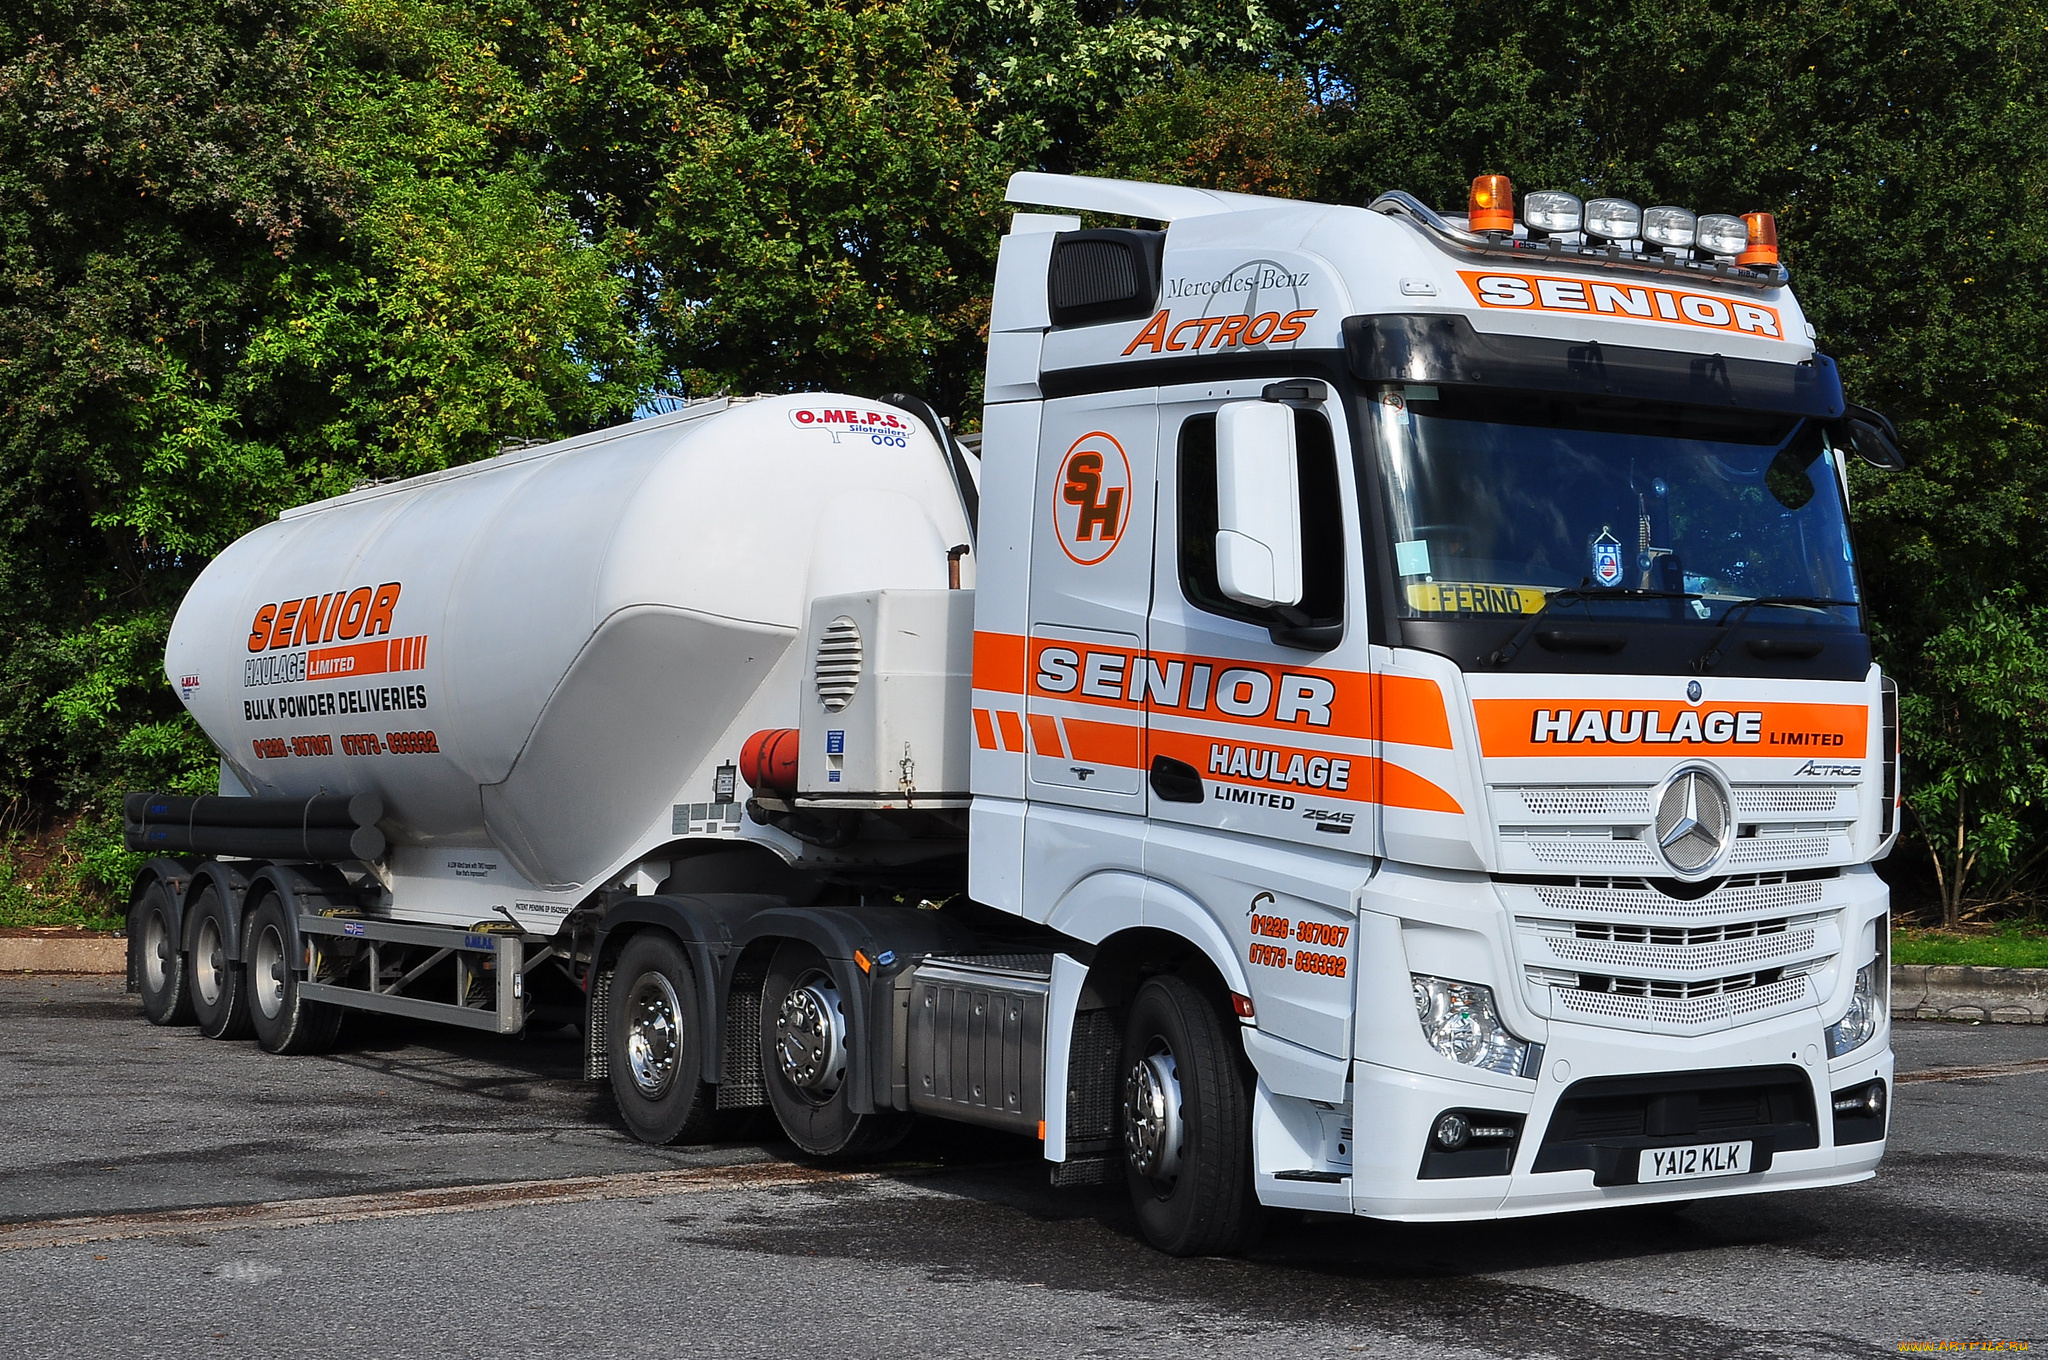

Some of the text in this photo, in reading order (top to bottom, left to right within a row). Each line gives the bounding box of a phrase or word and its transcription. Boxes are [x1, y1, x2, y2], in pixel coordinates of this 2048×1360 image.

[1167, 268, 1310, 299] Mercedes-Benz
[1476, 275, 1781, 338] SENIOR
[1120, 308, 1318, 357] ACTROS
[849, 424, 907, 437] Silotrailers
[247, 581, 402, 653] SENIOR
[244, 652, 356, 688] HAULAGE LIMITED
[1035, 646, 1336, 727] SENIOR
[243, 684, 428, 721] BULK POWDER DELIVERIES
[1529, 709, 1845, 747] HAULAGE LIMITED
[1208, 743, 1351, 792] HAULAGE
[1794, 760, 1862, 776] ACTROS
[1214, 786, 1295, 811] LIMITED
[1303, 808, 1356, 824] 2545
[1653, 1144, 1740, 1176] YA12 KLK
